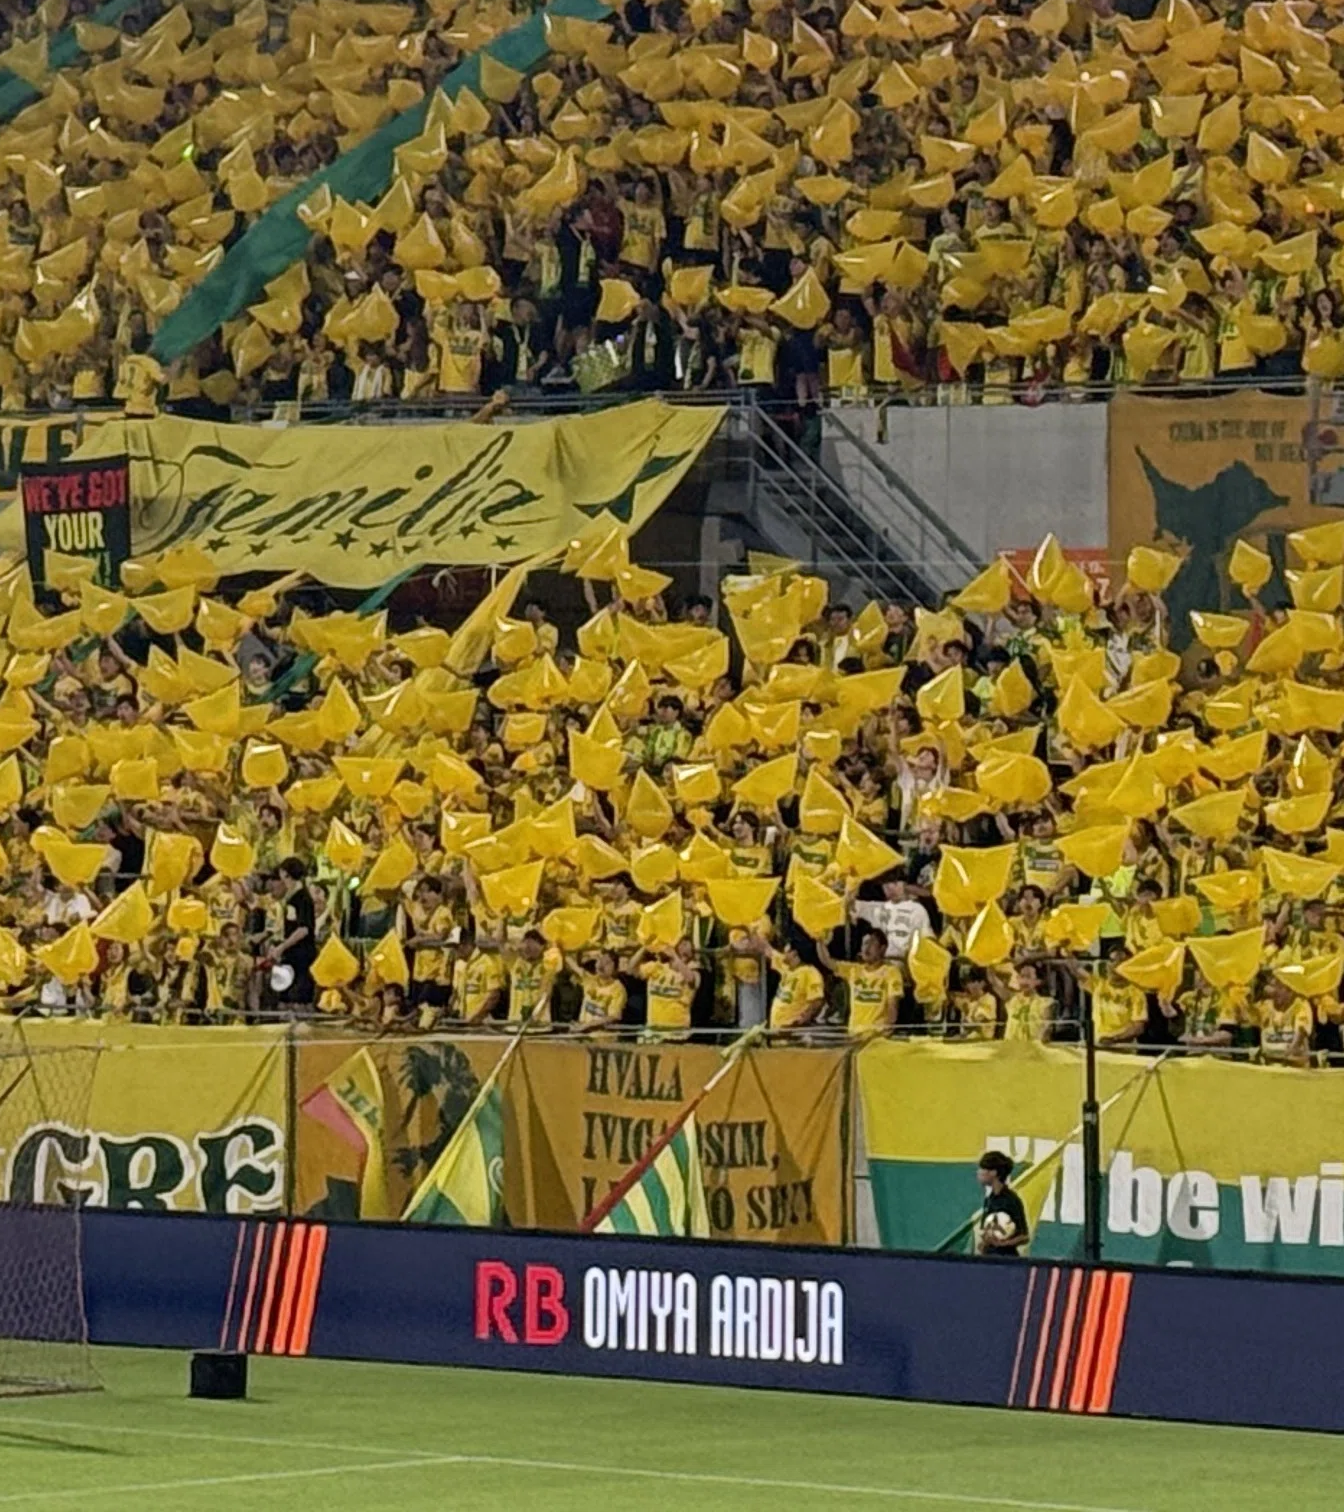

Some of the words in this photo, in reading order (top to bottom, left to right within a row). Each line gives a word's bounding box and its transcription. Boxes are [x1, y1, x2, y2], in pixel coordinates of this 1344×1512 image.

[88, 468, 126, 508] GOT
[44, 511, 105, 551] YOUR
[587, 1048, 684, 1101] HVALA
[1107, 1149, 1220, 1240] be
[474, 1260, 569, 1345] RB
[582, 1266, 697, 1355] OMIYA
[709, 1274, 845, 1366] ARDIJA
